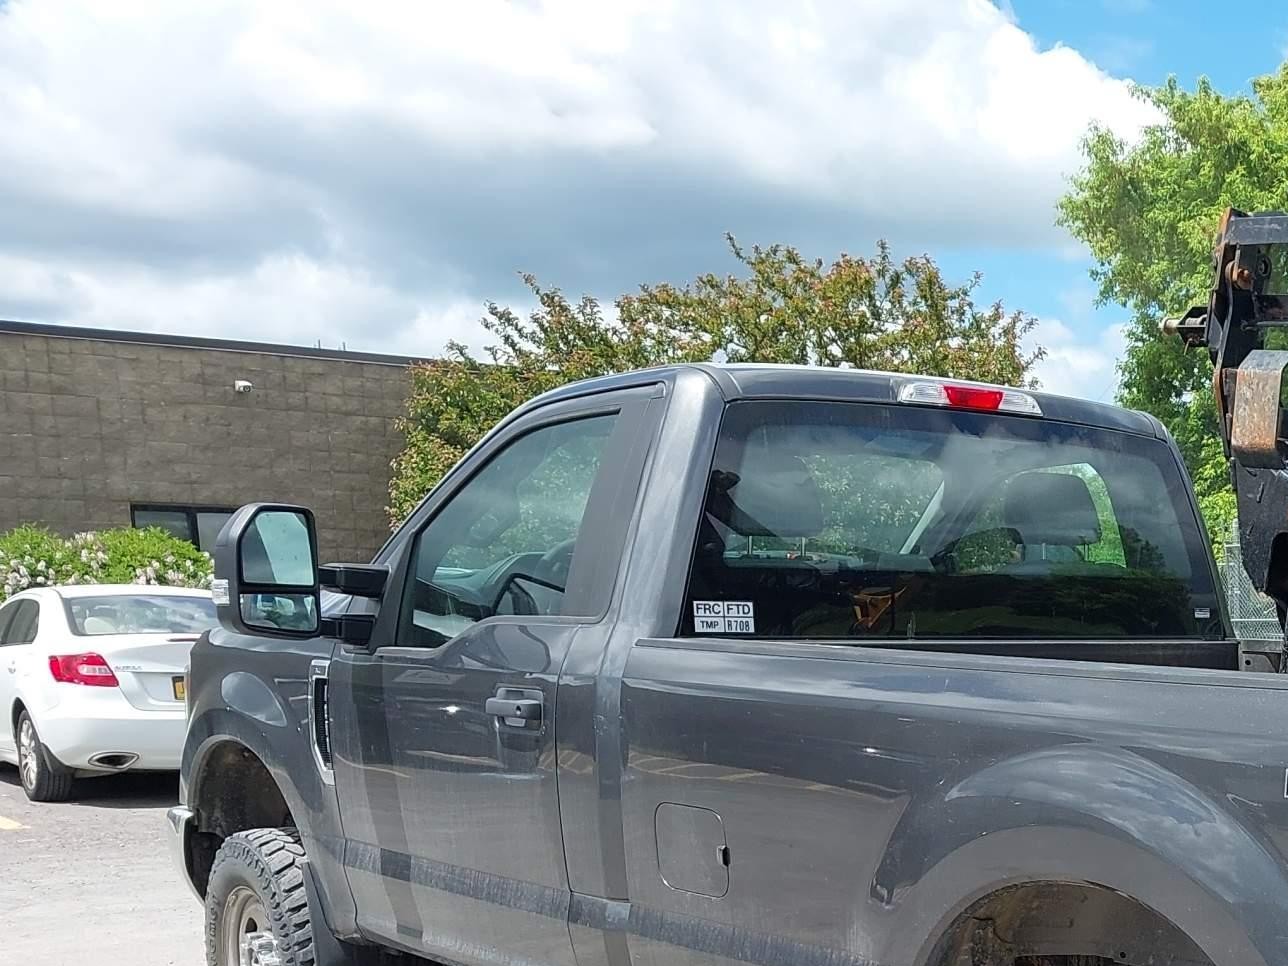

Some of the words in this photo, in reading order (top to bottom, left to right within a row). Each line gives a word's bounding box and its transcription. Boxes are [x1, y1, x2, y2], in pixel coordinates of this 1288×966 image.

[695, 603, 721, 615] FRC
[726, 603, 751, 615] FTD
[699, 620, 719, 629] TMP
